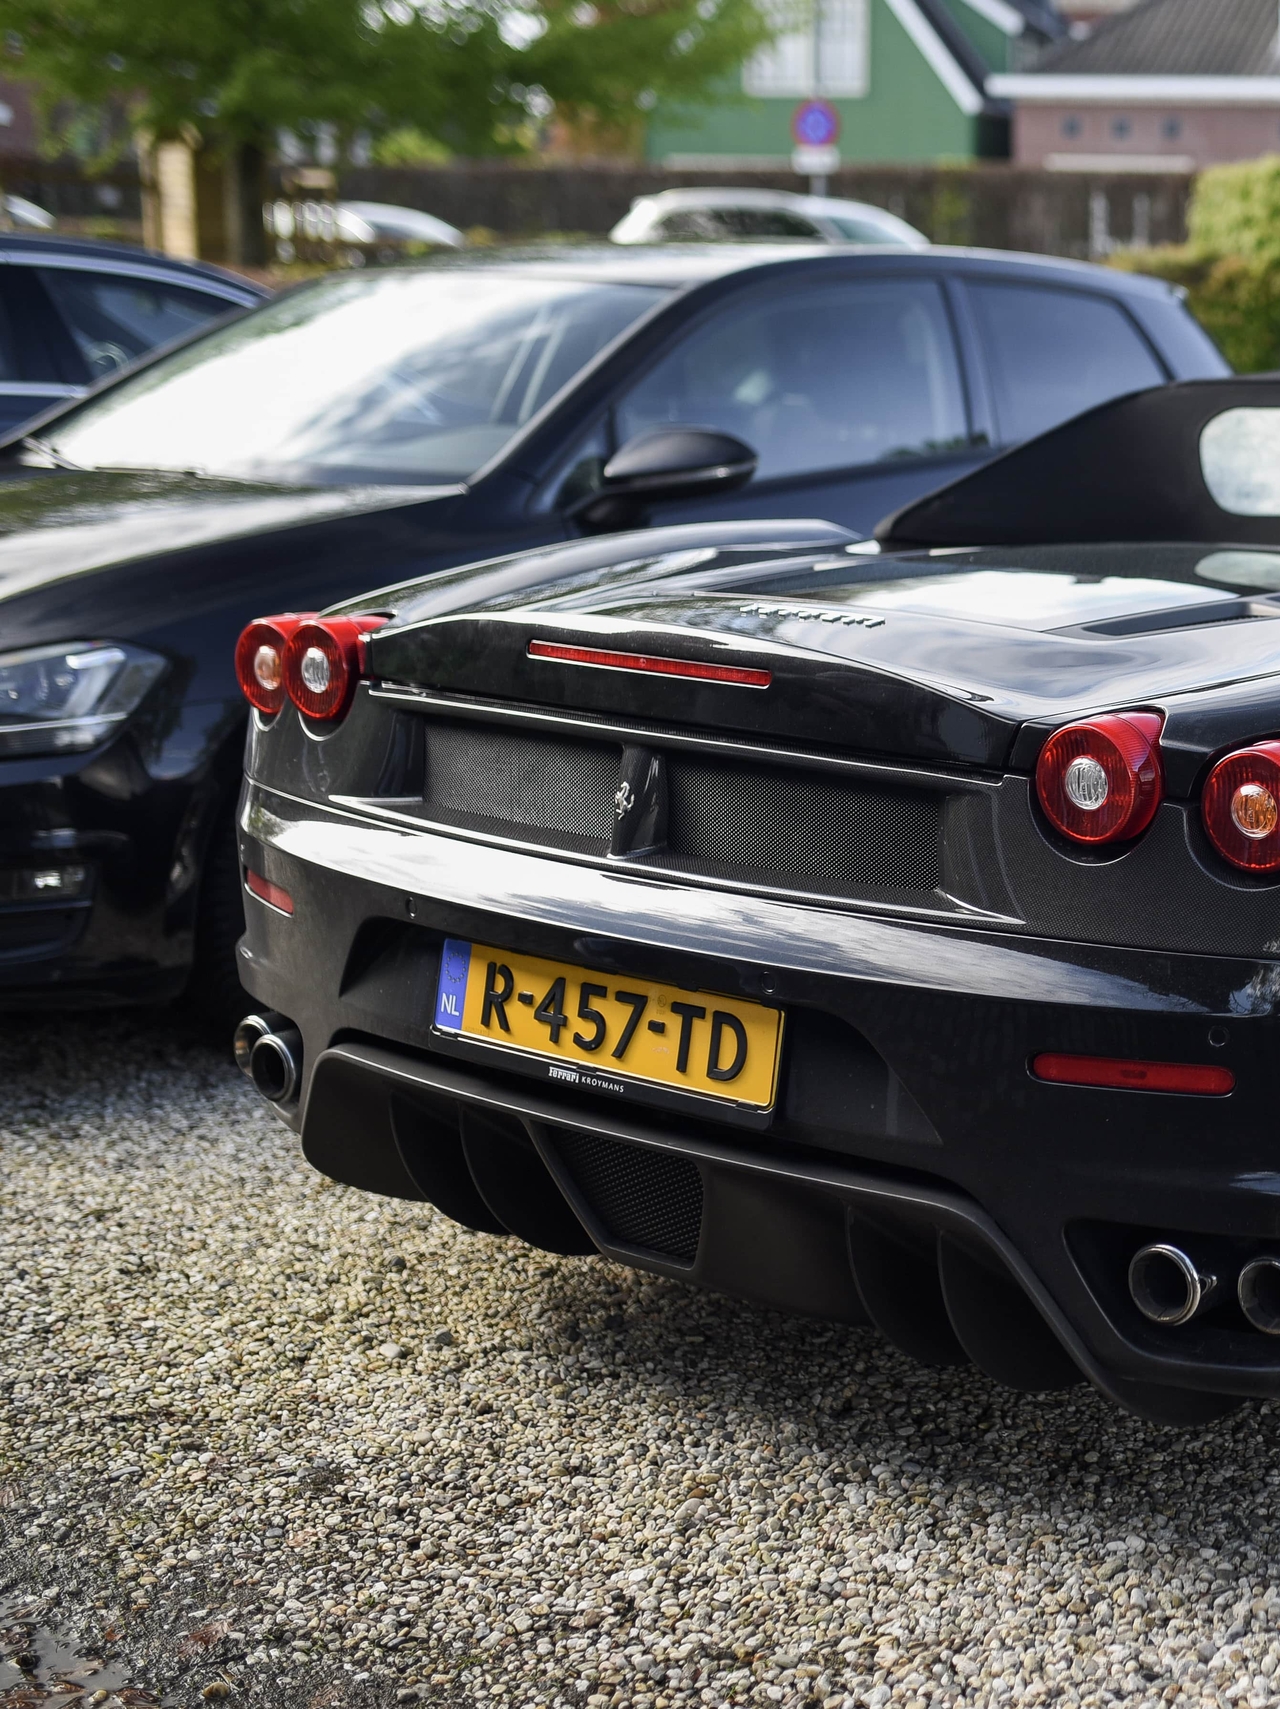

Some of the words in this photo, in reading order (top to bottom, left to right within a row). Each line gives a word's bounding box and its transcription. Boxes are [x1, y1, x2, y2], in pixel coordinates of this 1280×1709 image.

[440, 994, 460, 1016] NL
[480, 961, 748, 1081] R-457-TD
[581, 1076, 624, 1092] KROYMANS
